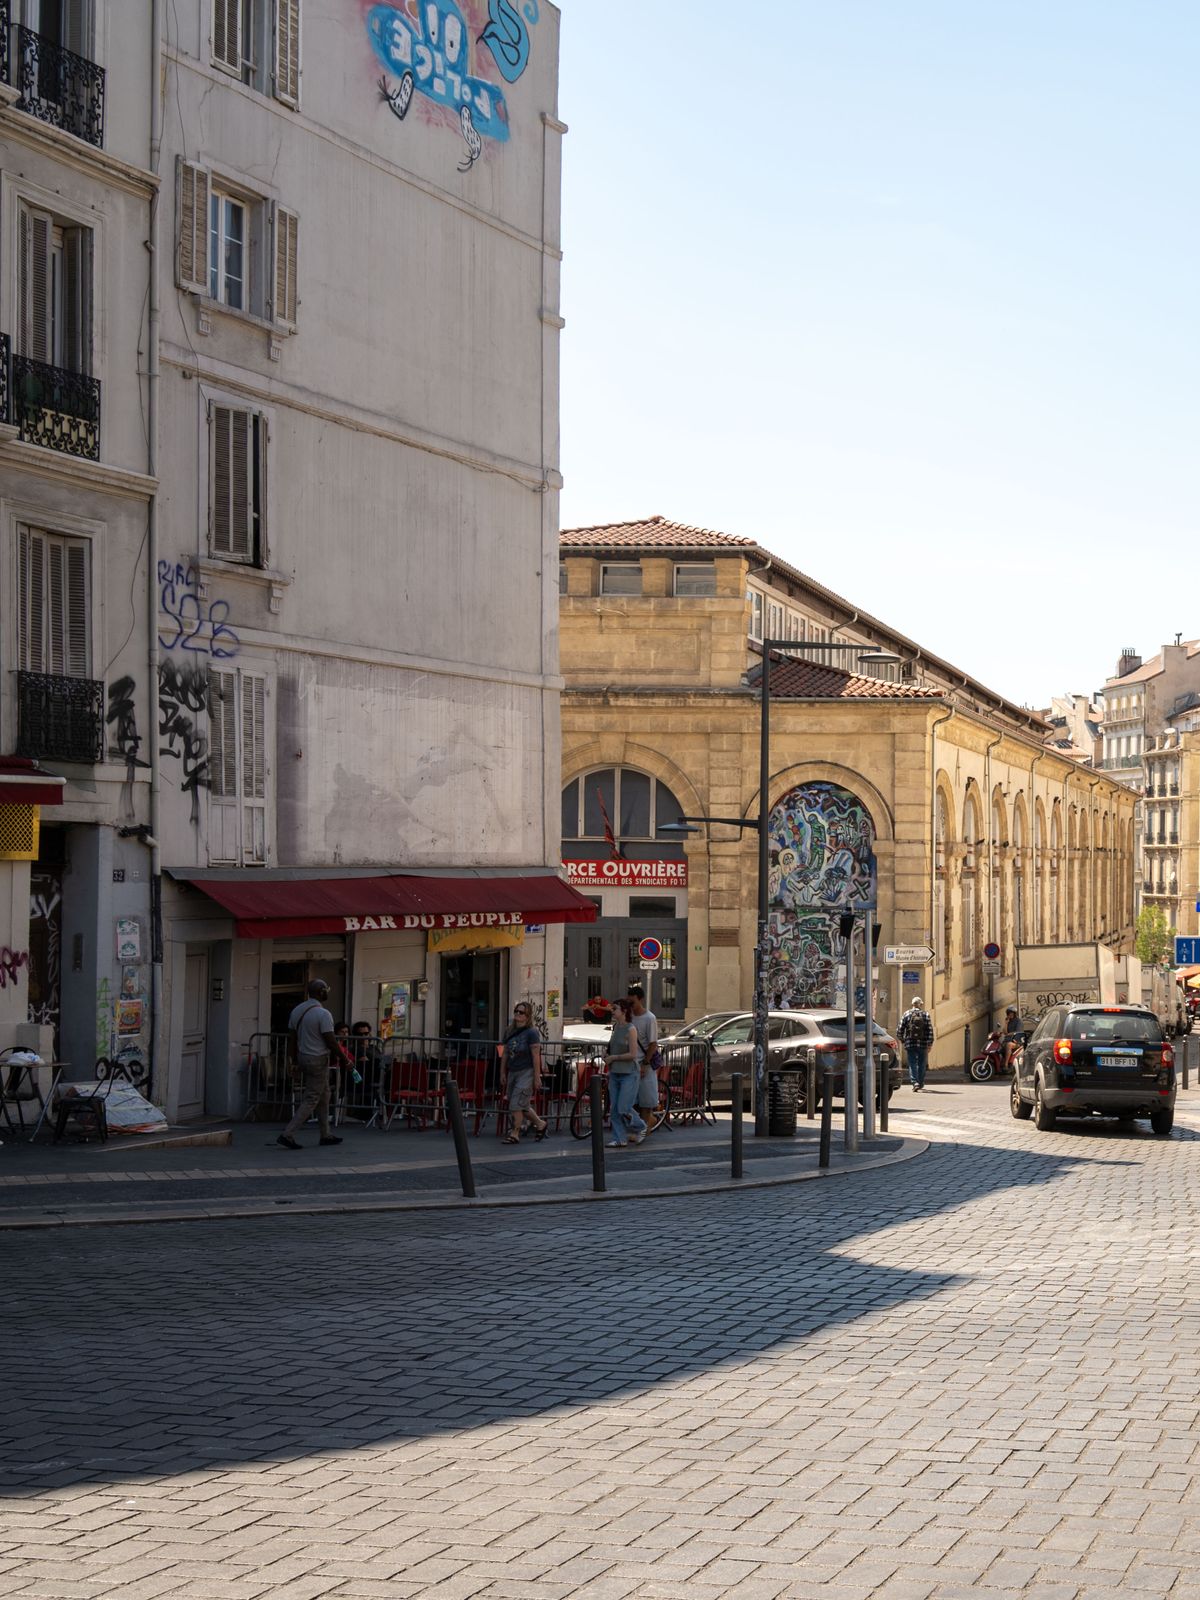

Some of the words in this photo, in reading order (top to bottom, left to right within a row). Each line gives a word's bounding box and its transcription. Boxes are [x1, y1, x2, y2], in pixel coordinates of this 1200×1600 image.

[562, 863, 597, 877] RCE
[344, 914, 397, 931] BAR
[404, 913, 435, 928] DU
[441, 911, 523, 928] PEUPLE
